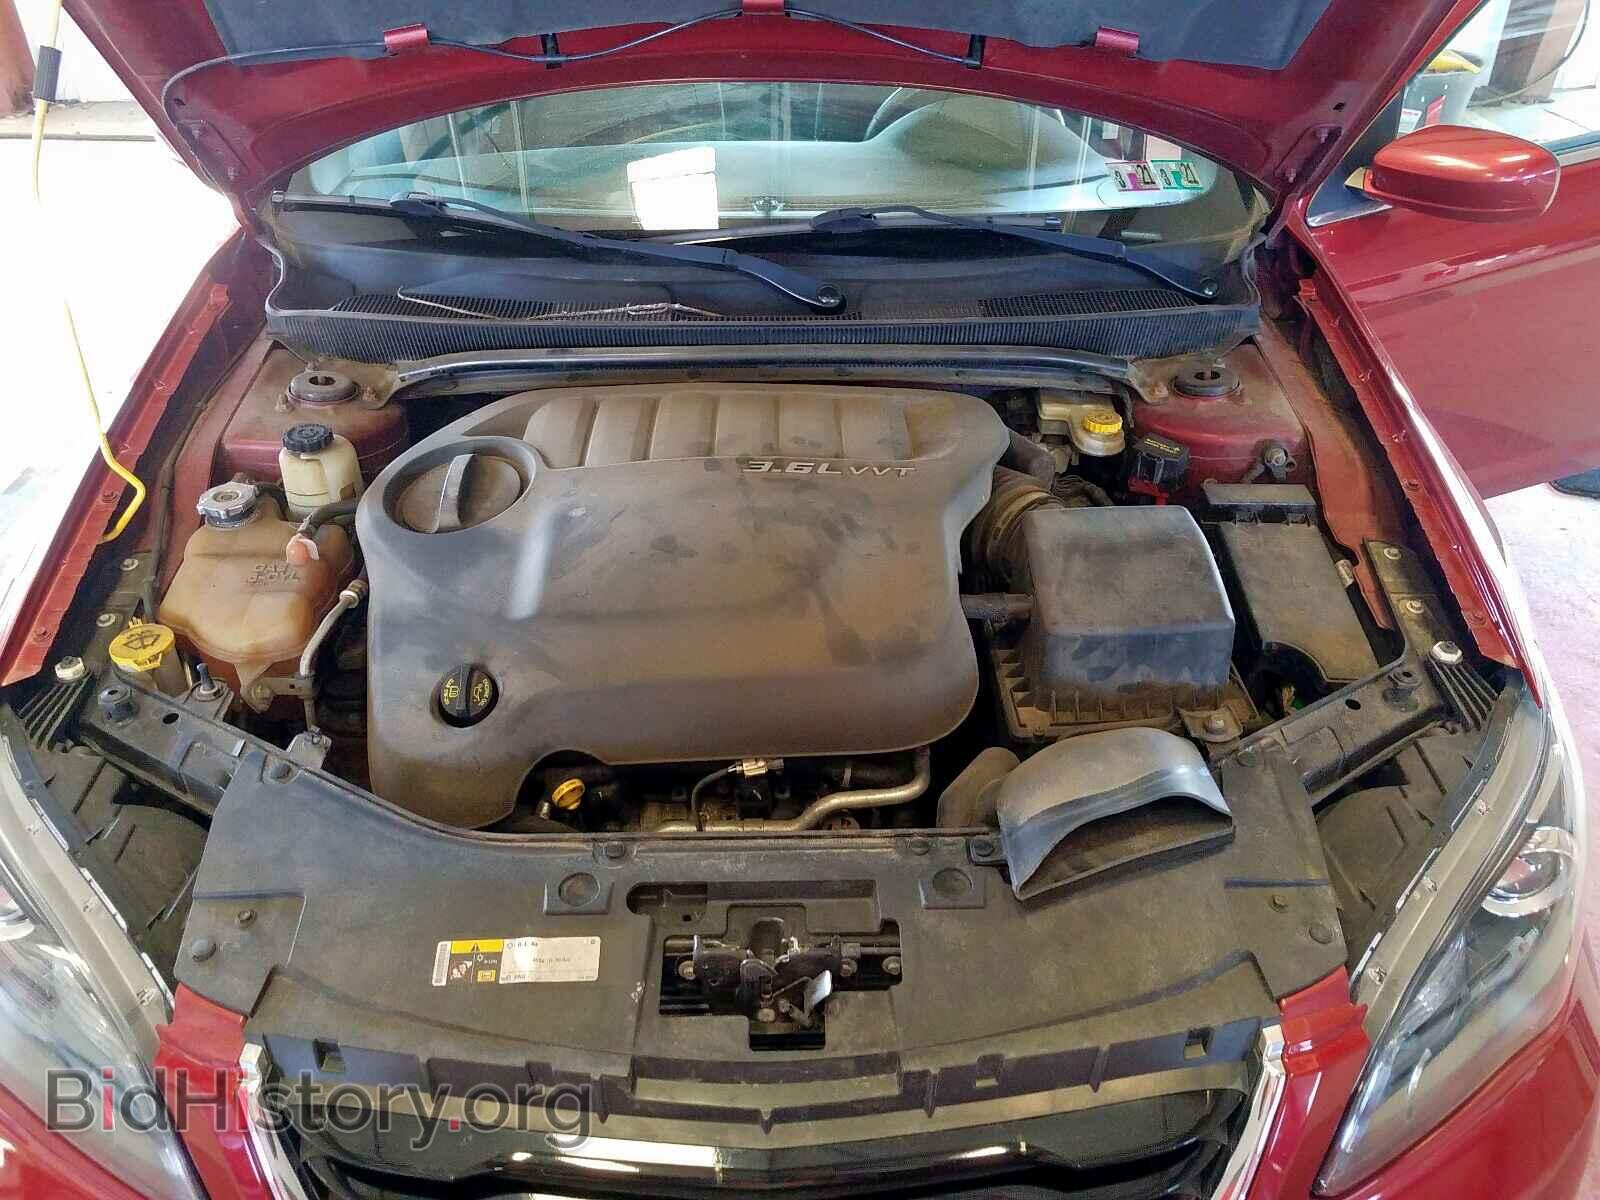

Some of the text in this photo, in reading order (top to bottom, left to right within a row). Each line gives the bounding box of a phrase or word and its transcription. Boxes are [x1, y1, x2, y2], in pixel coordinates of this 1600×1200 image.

[1135, 164, 1156, 185] 21
[1179, 162, 1200, 185] 21
[743, 460, 916, 478] 3.6L VVT
